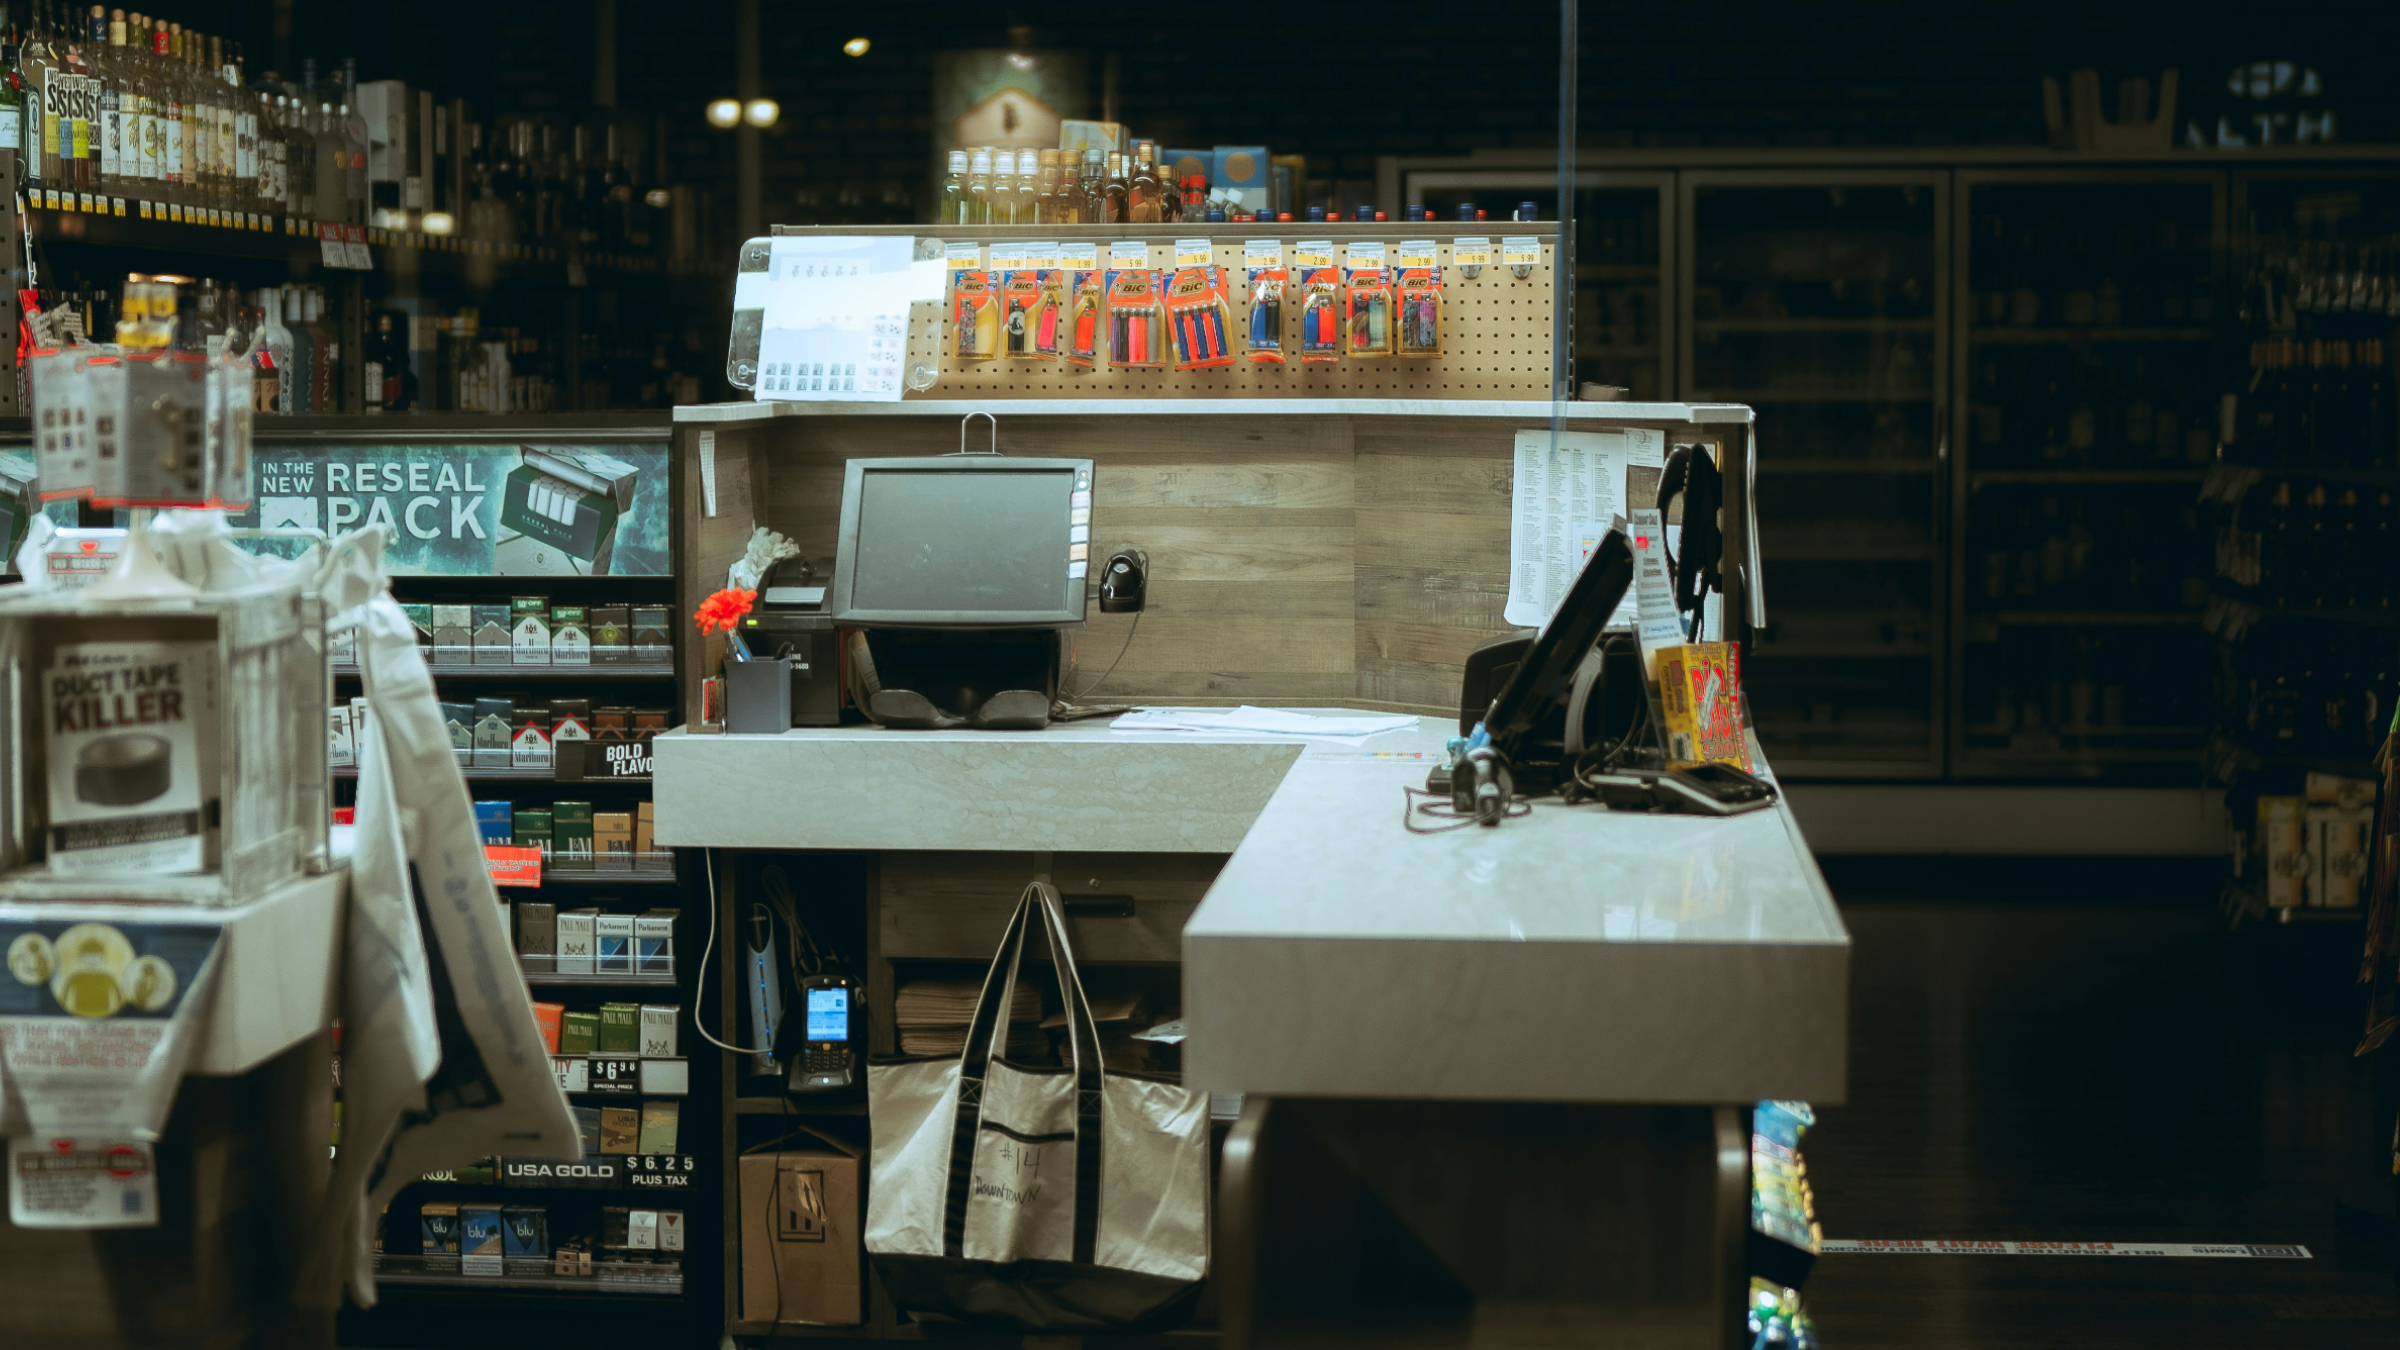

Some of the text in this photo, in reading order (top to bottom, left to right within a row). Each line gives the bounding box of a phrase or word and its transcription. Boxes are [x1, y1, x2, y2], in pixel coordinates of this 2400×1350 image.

[262, 462, 314, 475] IN THE
[327, 462, 486, 493] RESEAL
[262, 477, 314, 493] NEW
[327, 494, 487, 540] PACK
[521, 514, 572, 540] RESEAL PACK
[529, 600, 543, 609] OFF
[52, 662, 182, 700] DUCT TAPE
[53, 689, 185, 734] KILLER
[514, 746, 550, 764] Marlboro
[606, 742, 643, 763] BOLD
[560, 919, 591, 933] PALL MALL
[599, 921, 629, 931] Parliament
[638, 922, 668, 933] Parliament
[602, 1011, 633, 1025] PALL MALL
[643, 1012, 673, 1026] PALL MALL
[567, 1024, 593, 1037] PALL MALL
[999, 1142, 1041, 1180] #14
[508, 1164, 614, 1178] USA GOLD
[632, 1174, 688, 1186] PLUS TAX
[975, 1175, 1042, 1205] DOWNTOWN
[432, 1222, 448, 1234] blu
[467, 1225, 486, 1239] blu
[516, 1224, 534, 1237] blu
[1857, 1239, 2115, 1250] PLEASE WAIT HERE
